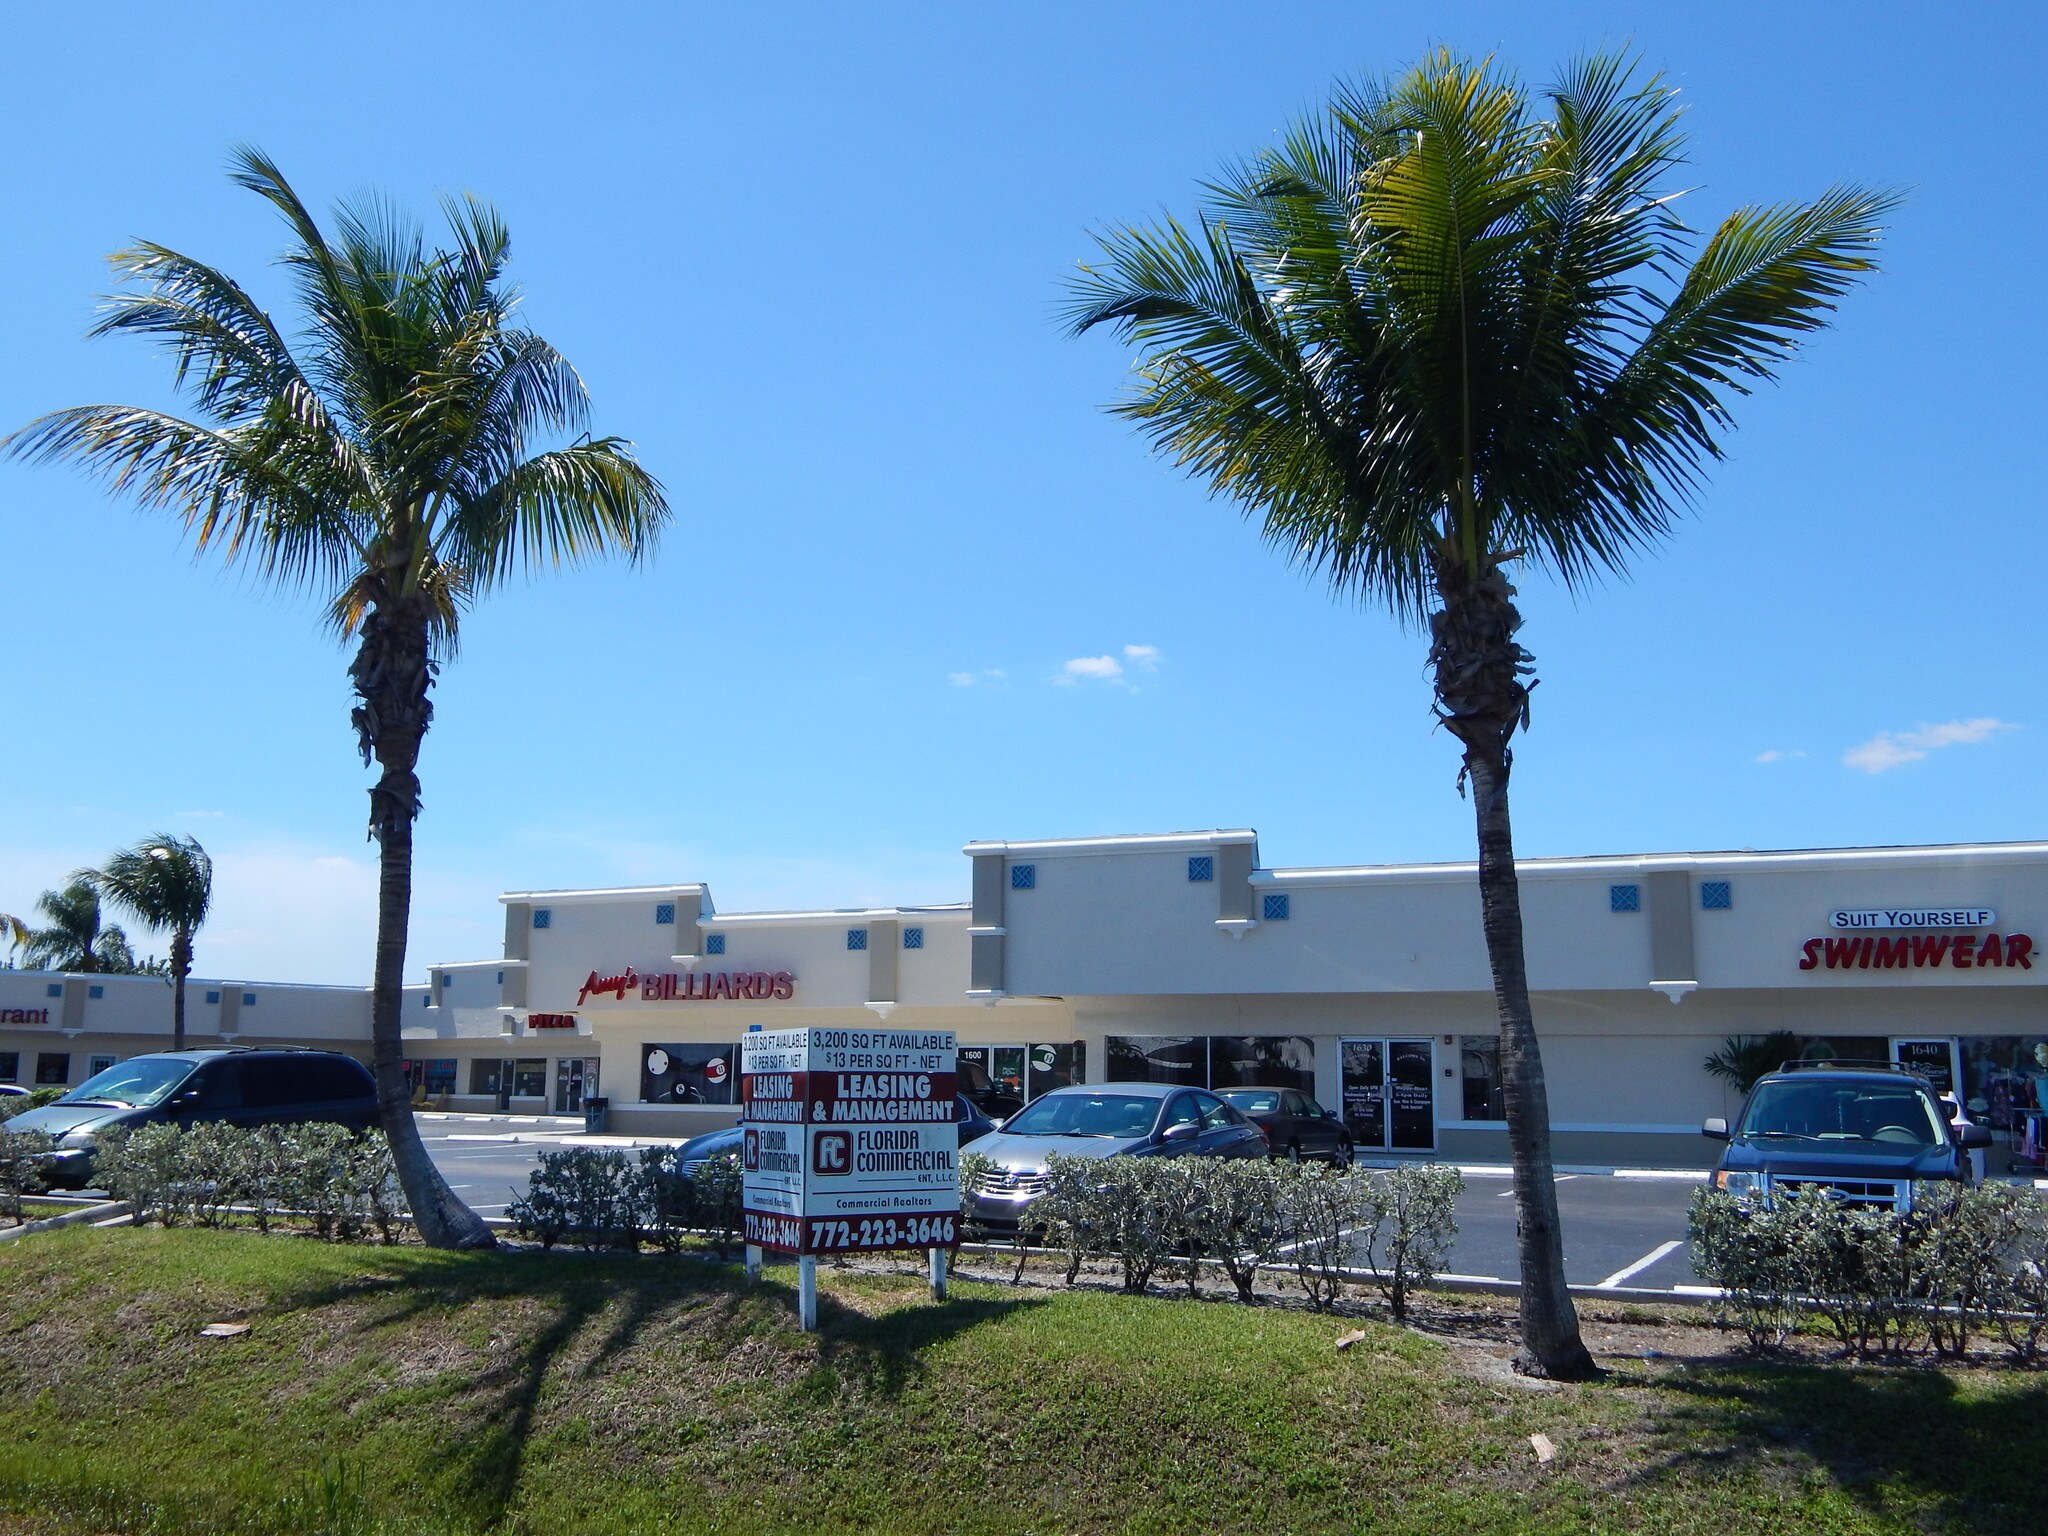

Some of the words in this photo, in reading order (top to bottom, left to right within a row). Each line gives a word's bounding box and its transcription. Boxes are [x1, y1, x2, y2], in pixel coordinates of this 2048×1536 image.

[1836, 911, 1879, 927] SUIT
[1885, 911, 1988, 926] YOURSELF
[1799, 933, 2033, 970] SWIMWEAR
[577, 966, 638, 1006] Amy's
[641, 971, 794, 1001] BILLIARDS
[529, 1014, 575, 1029] PIZZA
[760, 1035, 768, 1051] SQ
[769, 1035, 775, 1050] FT
[776, 1033, 807, 1049] AVAILABLE
[814, 1031, 848, 1050] 3,200
[852, 1033, 869, 1049] SQ
[873, 1034, 887, 1049] FT
[889, 1034, 953, 1050] AVAILABLE
[1353, 1044, 1372, 1052] 1630
[1912, 1045, 1937, 1055] 1640
[759, 1055, 769, 1069] PER
[770, 1055, 778, 1069] SQ
[779, 1055, 786, 1068] FT
[791, 1053, 801, 1068] NET
[826, 1051, 846, 1068] $13
[850, 1054, 873, 1068] PER
[876, 1054, 892, 1068] SQ
[896, 1055, 909, 1068] FT
[920, 1055, 942, 1069] NET
[965, 1051, 981, 1059] 1600
[753, 1075, 793, 1099] LEASING
[838, 1075, 931, 1099] LEASING
[744, 1101, 750, 1119] &
[751, 1101, 803, 1121] MANAGEMENT
[813, 1100, 827, 1121] &
[832, 1100, 954, 1121] MANAGEMENT
[761, 1131, 786, 1151] FLORIDA
[858, 1130, 919, 1150] FLORIDA
[761, 1152, 801, 1174] COMMERCIAL
[857, 1150, 954, 1172] COMMERCIAL
[918, 1174, 933, 1184] ENT,
[936, 1173, 955, 1182] L.L.C.
[837, 1197, 890, 1208] Commercial
[894, 1196, 932, 1207] Realtors
[745, 1214, 800, 1248] 772-223-3646
[811, 1217, 954, 1248] 772-223-3646
